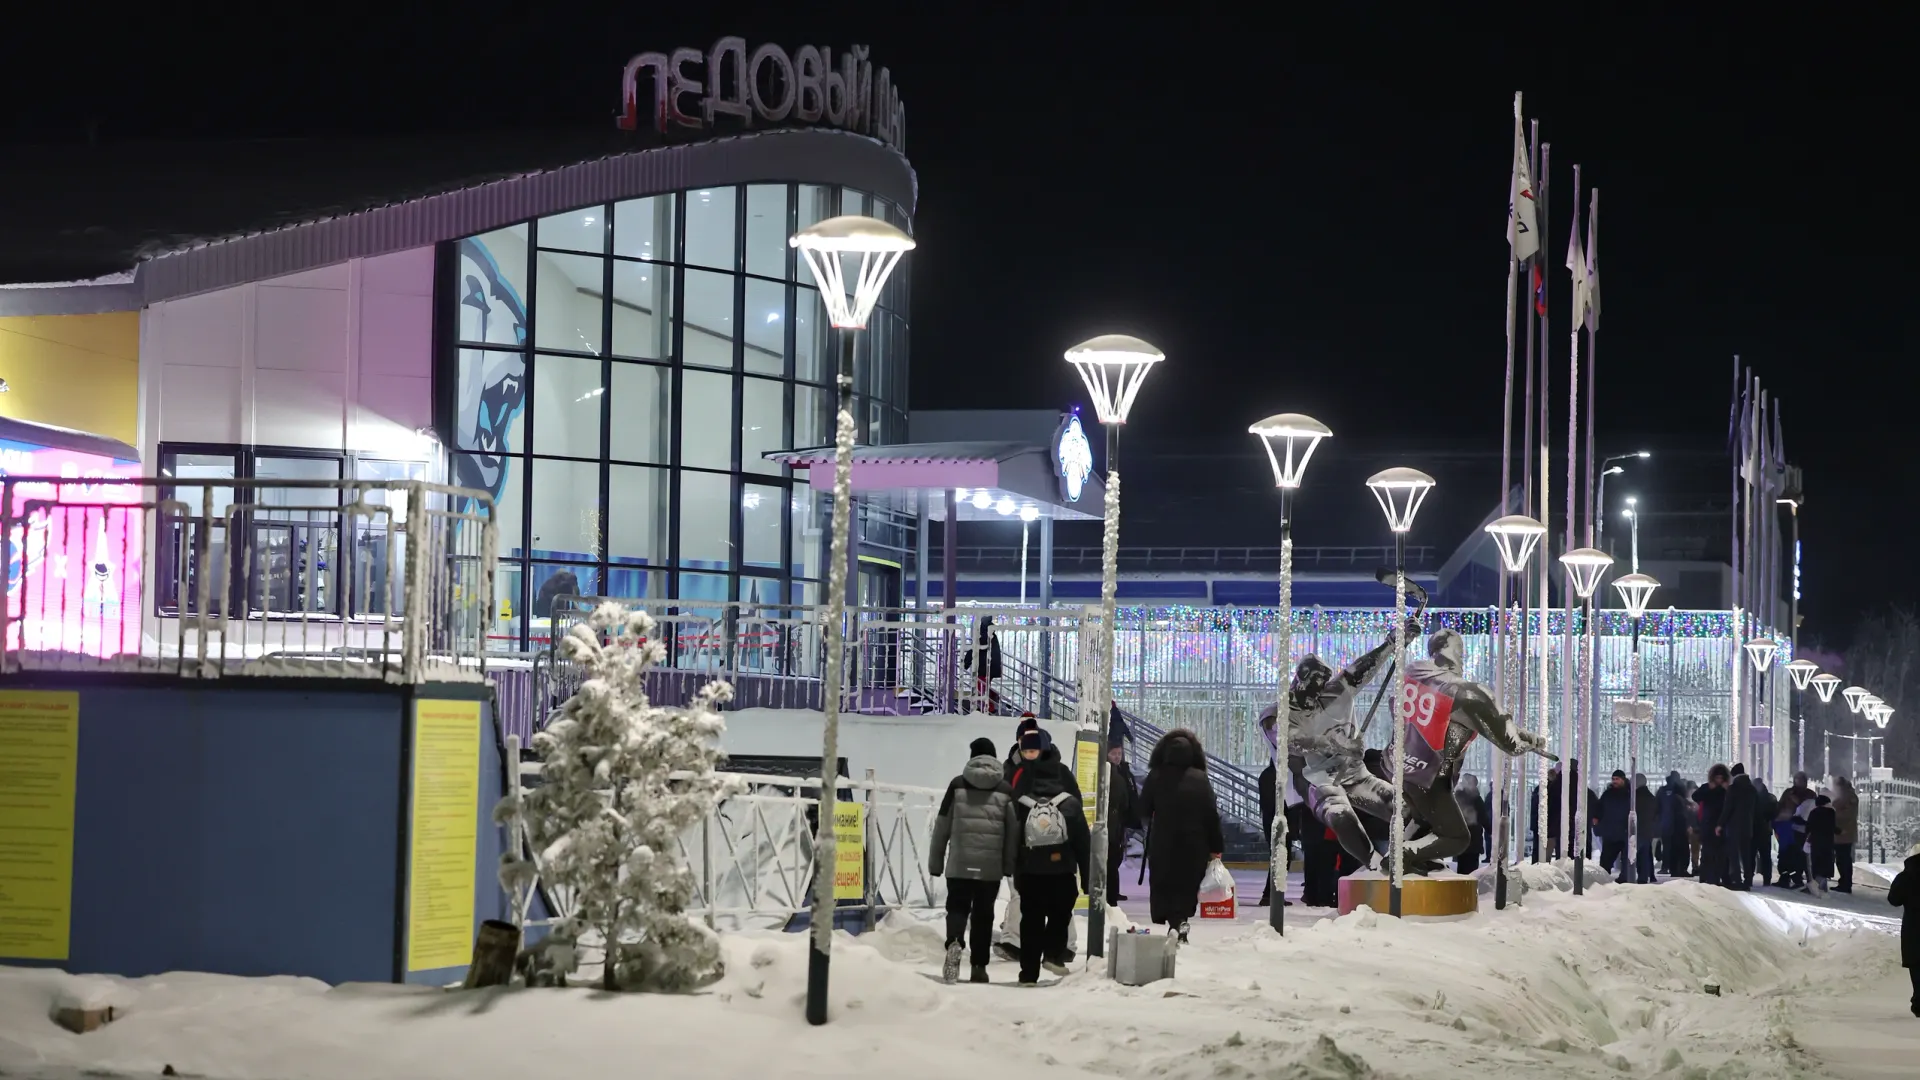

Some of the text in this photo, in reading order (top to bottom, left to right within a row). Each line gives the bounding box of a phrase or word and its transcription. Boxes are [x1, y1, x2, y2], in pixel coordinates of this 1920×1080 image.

[616, 35, 872, 134] ЛЕДОВЫЙ
[1402, 683, 1436, 726] 89
[835, 809, 859, 828] мание!
[836, 867, 861, 889] ещено!
